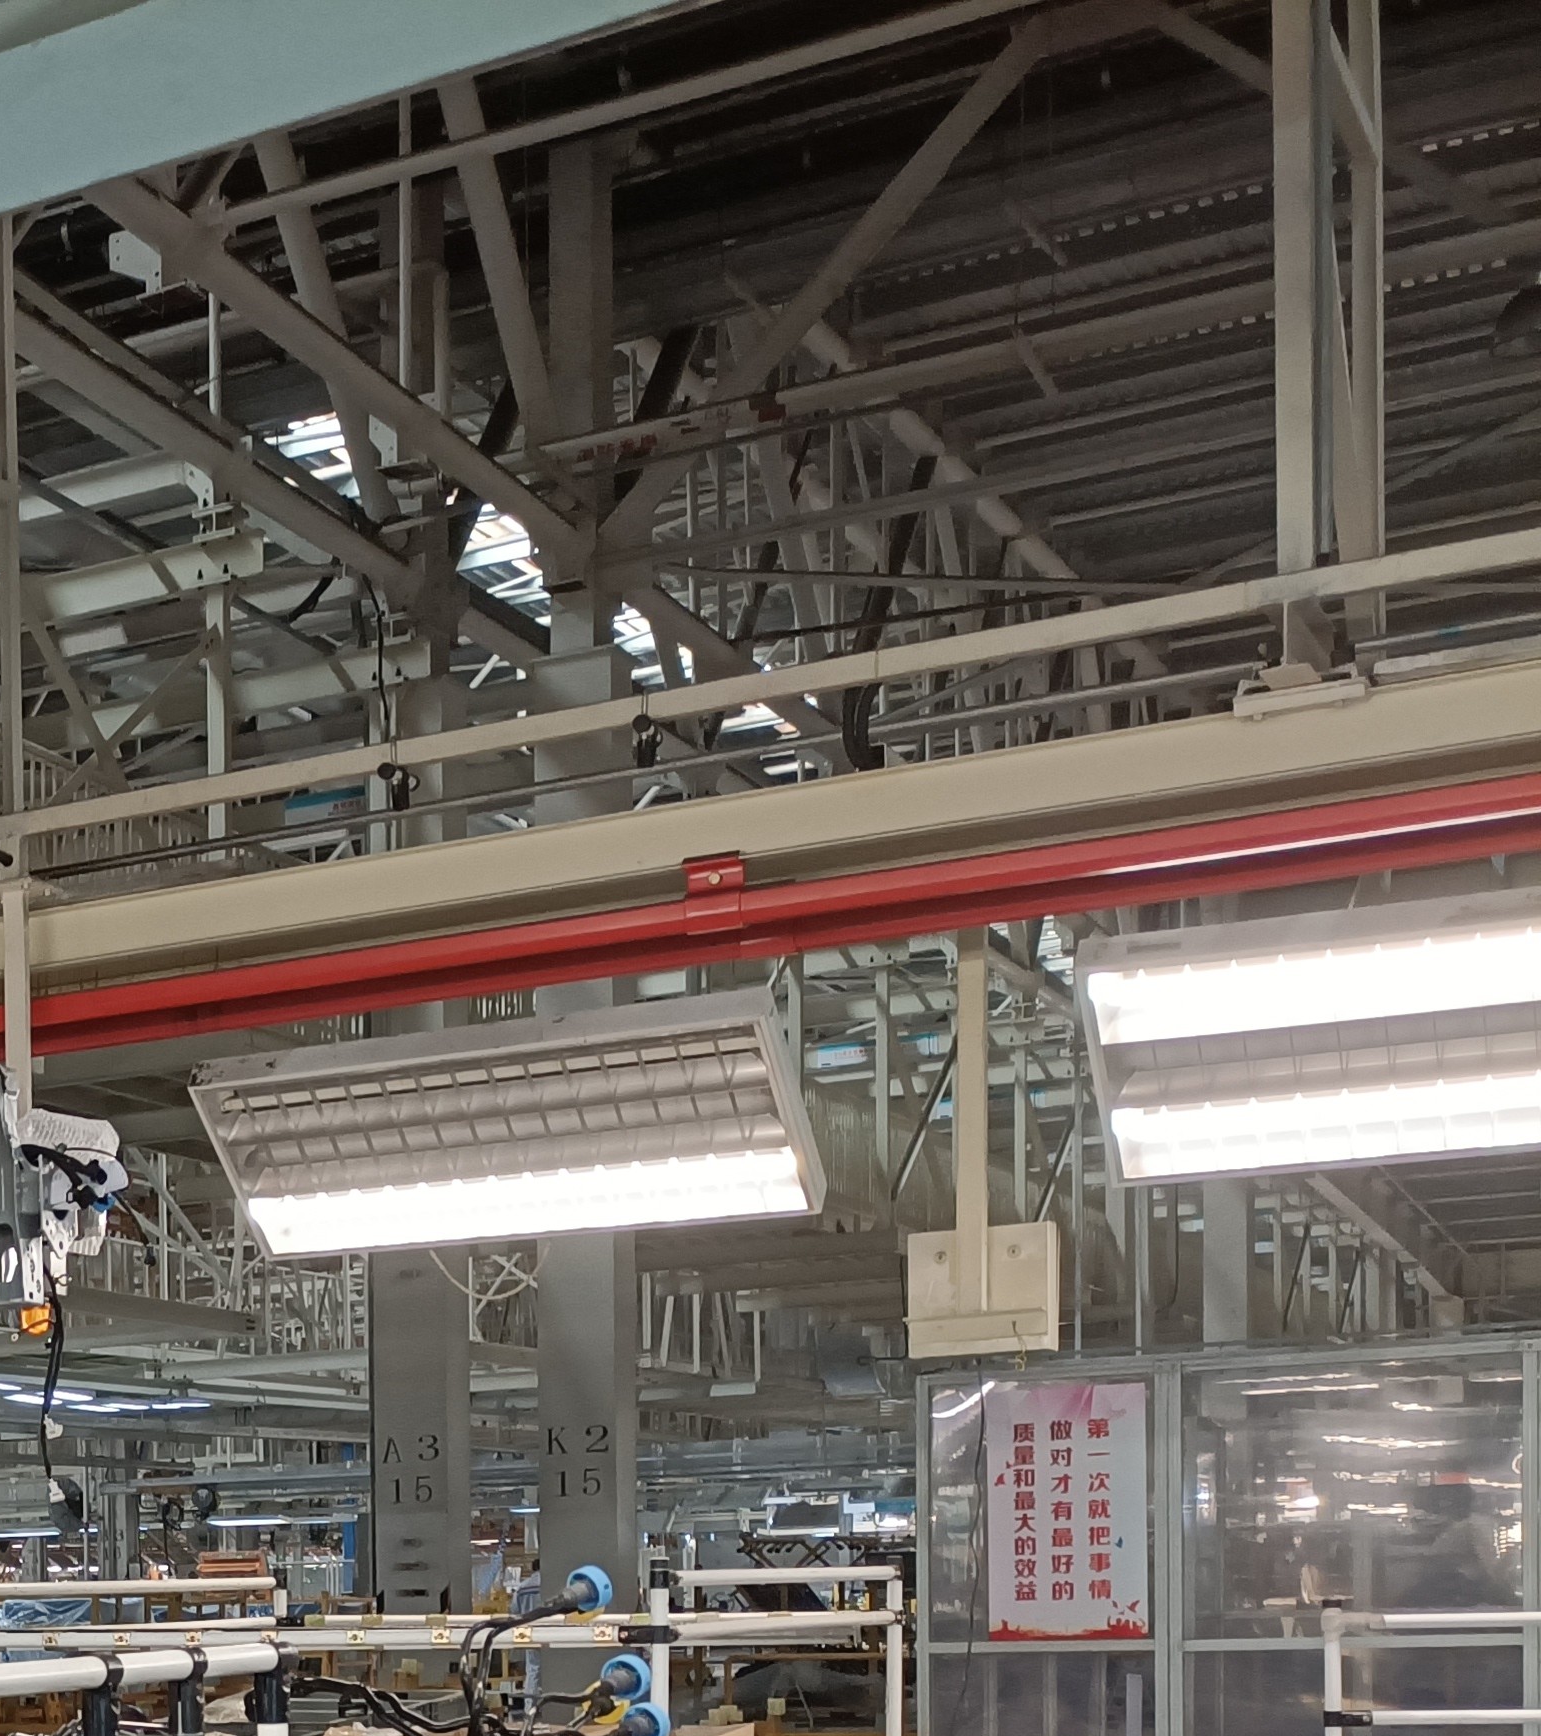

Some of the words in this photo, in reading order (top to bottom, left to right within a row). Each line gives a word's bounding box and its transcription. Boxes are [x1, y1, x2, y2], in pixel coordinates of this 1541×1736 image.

[391, 1475, 433, 1505] 15
[558, 1468, 601, 1497] 15
[1013, 1422, 1037, 1602] 质量和最大的效益
[1049, 1420, 1074, 1601] 做对才有最好的
[1086, 1417, 1112, 1600] 第一次就把事情
